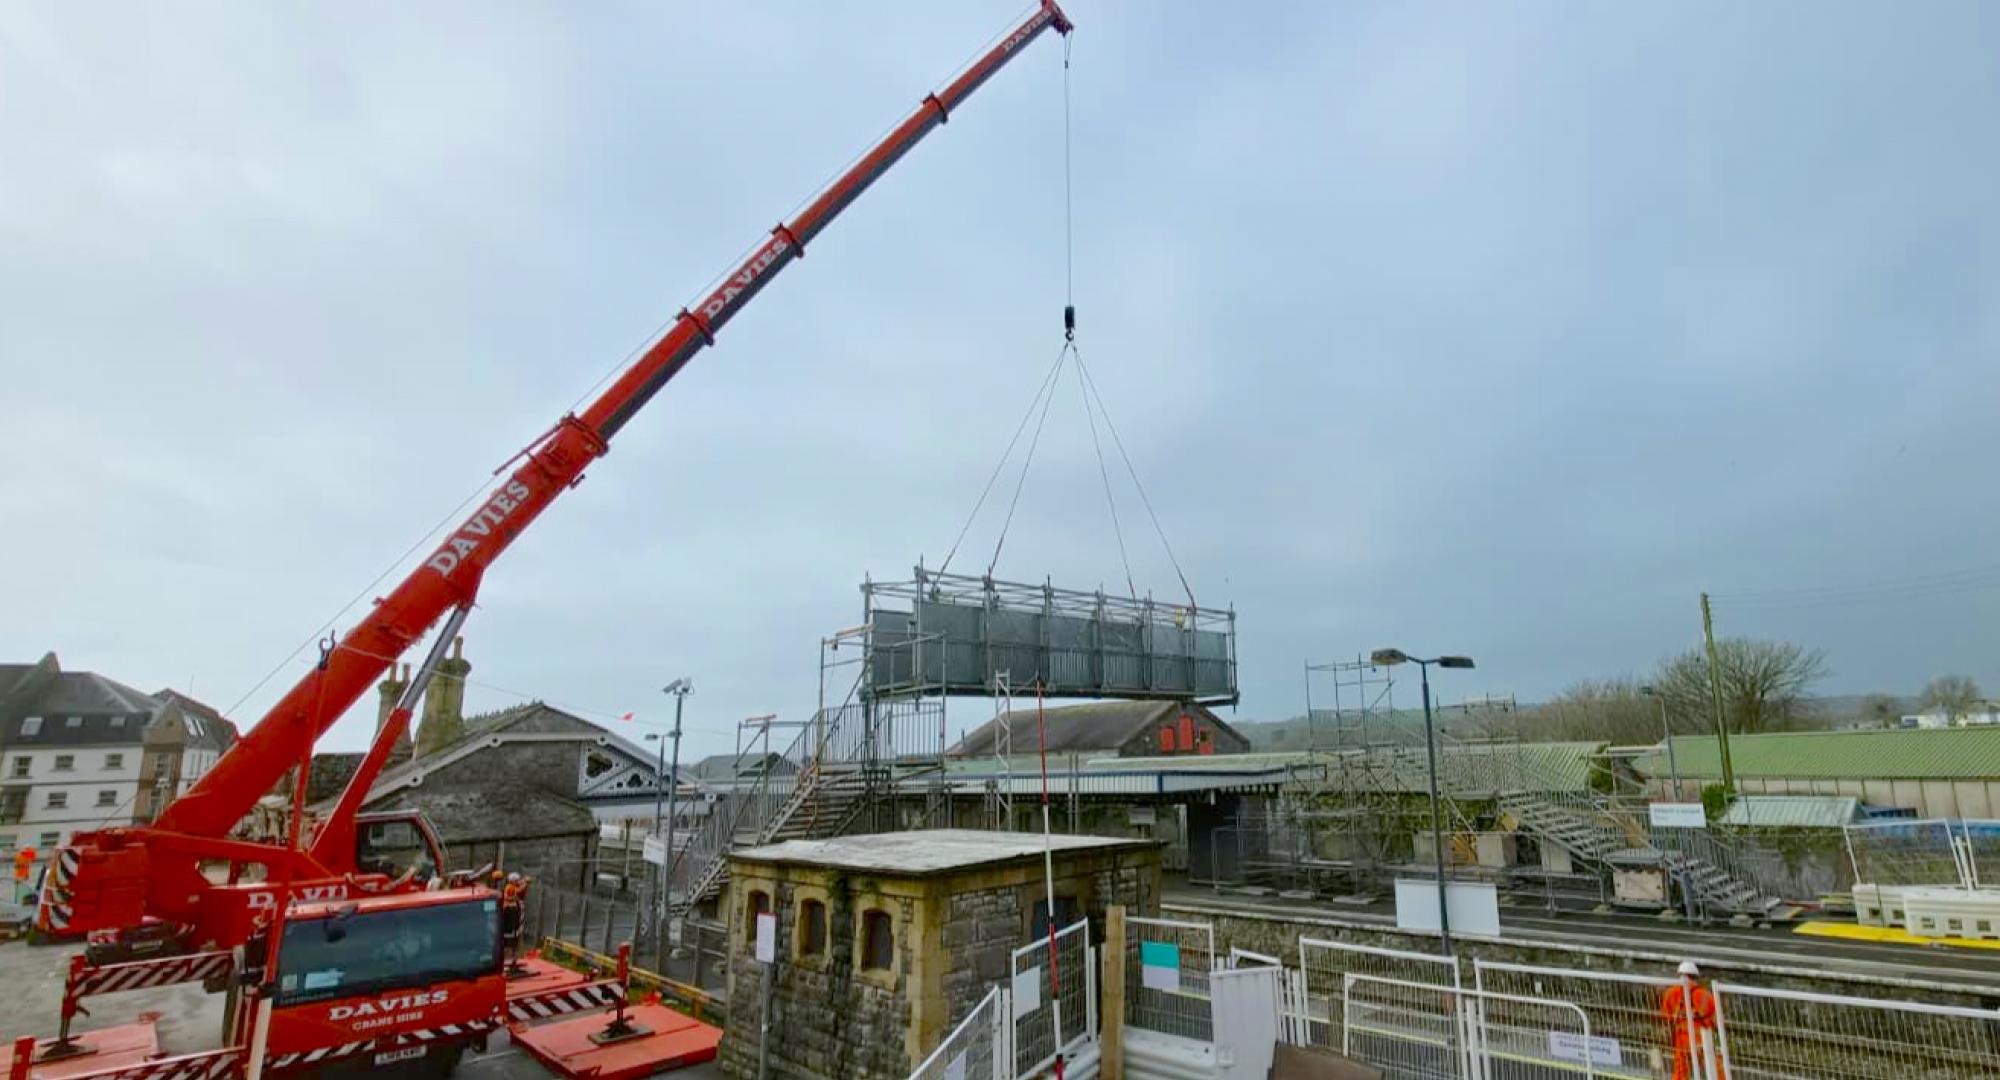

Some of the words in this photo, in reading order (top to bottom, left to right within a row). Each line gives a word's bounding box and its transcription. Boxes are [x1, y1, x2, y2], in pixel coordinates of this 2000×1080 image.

[1003, 9, 1052, 51] DAVIES
[704, 240, 787, 319] DAVIES
[427, 480, 530, 577] DAVIES
[329, 990, 449, 1020] DAVIES
[352, 1016, 394, 1031] CRANE
